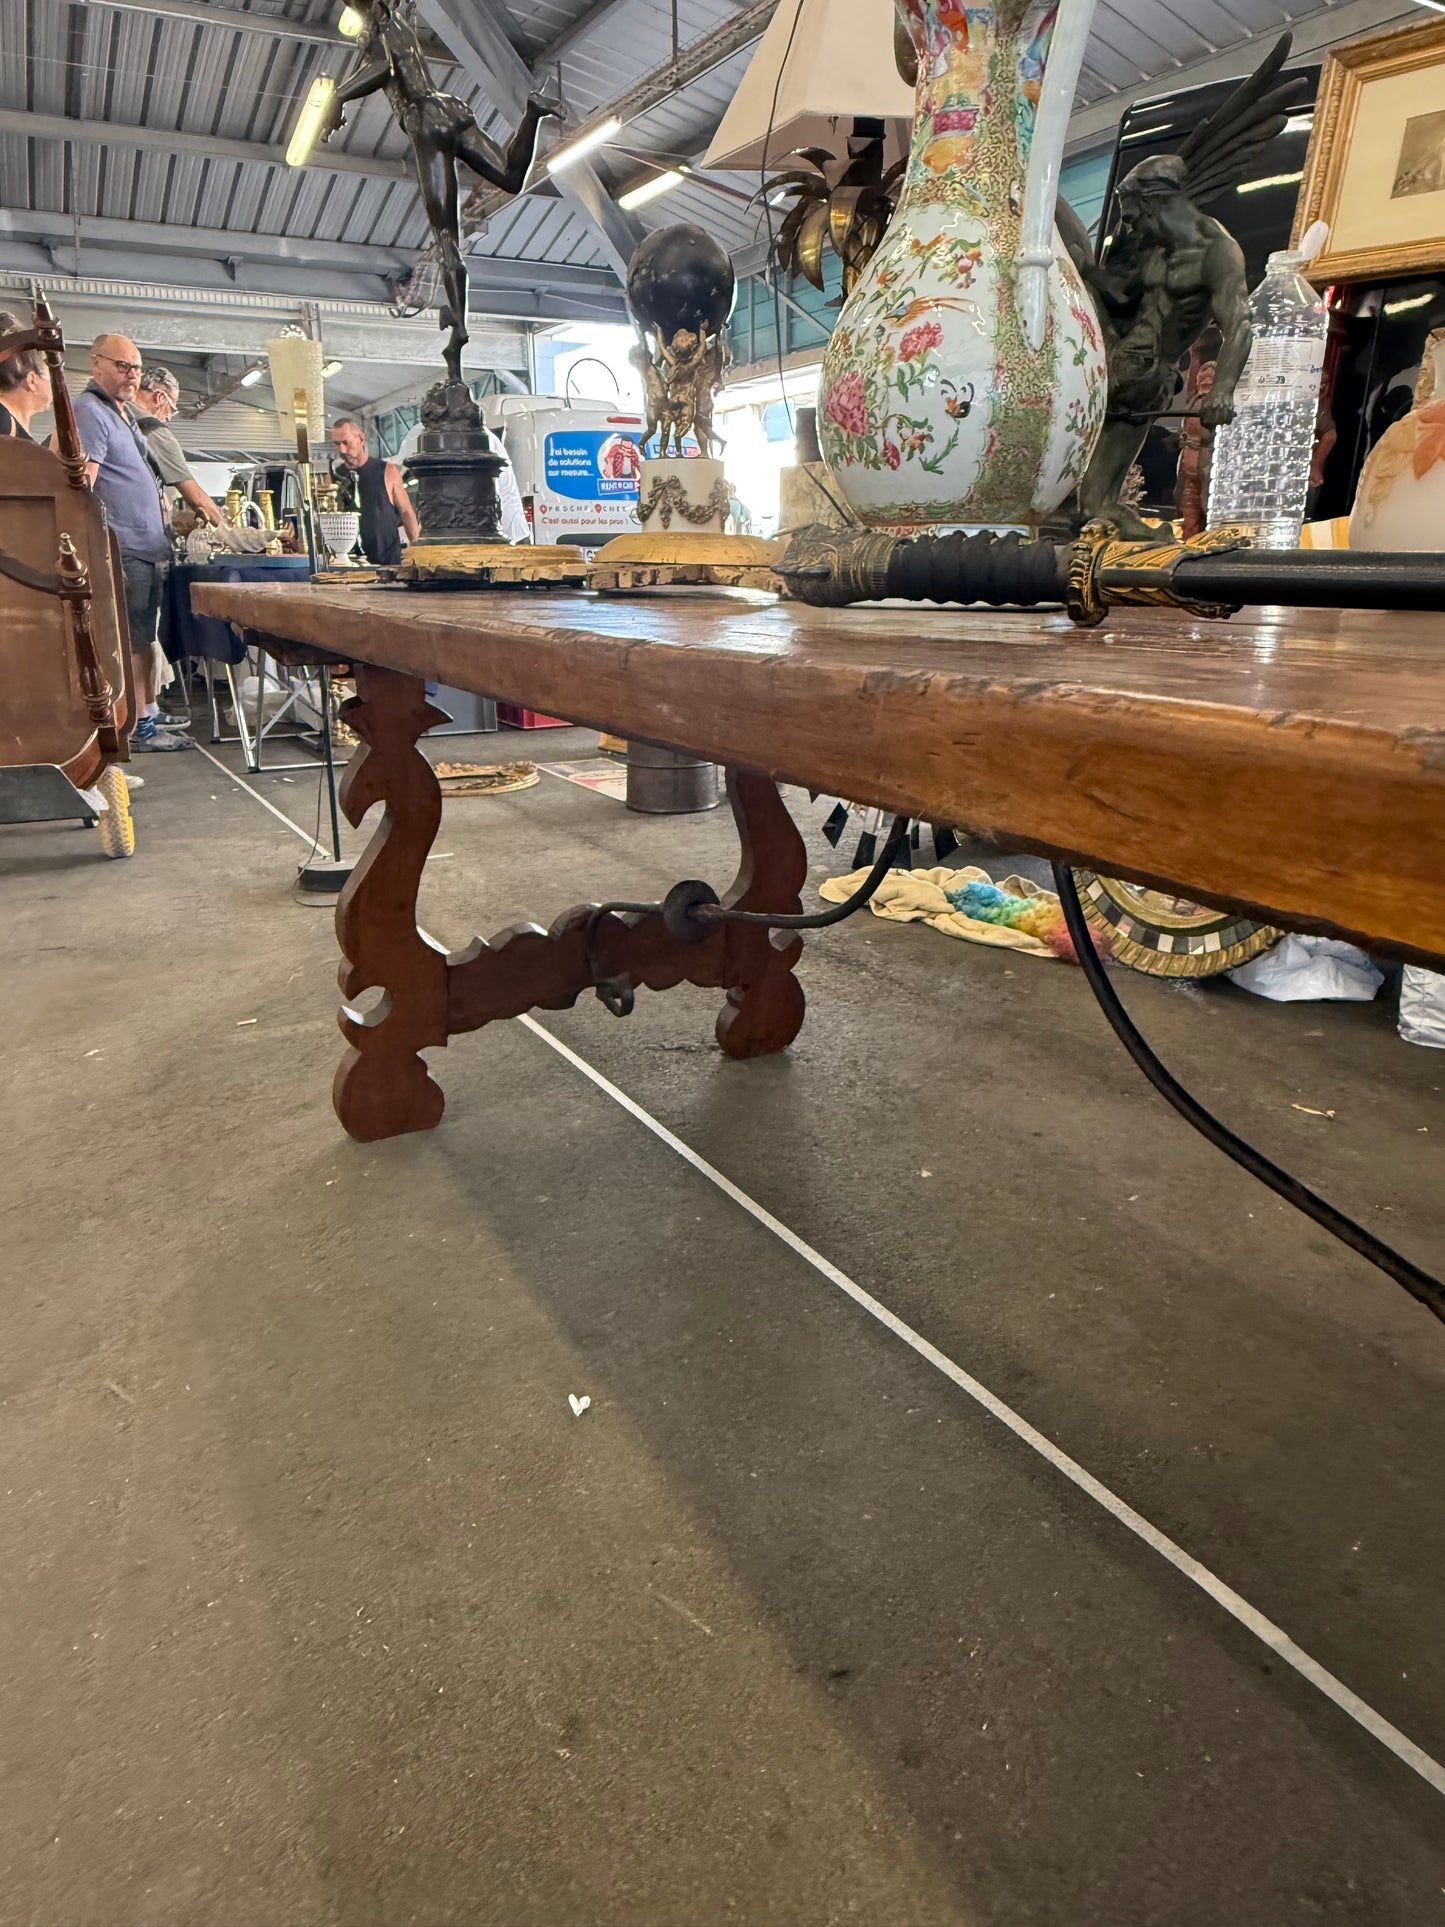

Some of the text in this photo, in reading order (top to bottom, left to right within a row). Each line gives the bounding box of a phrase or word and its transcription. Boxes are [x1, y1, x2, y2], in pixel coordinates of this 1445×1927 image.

[562, 447, 588, 456] besoin
[548, 458, 592, 466] de solutions
[580, 518, 597, 526] pour
[609, 518, 624, 526] pros
